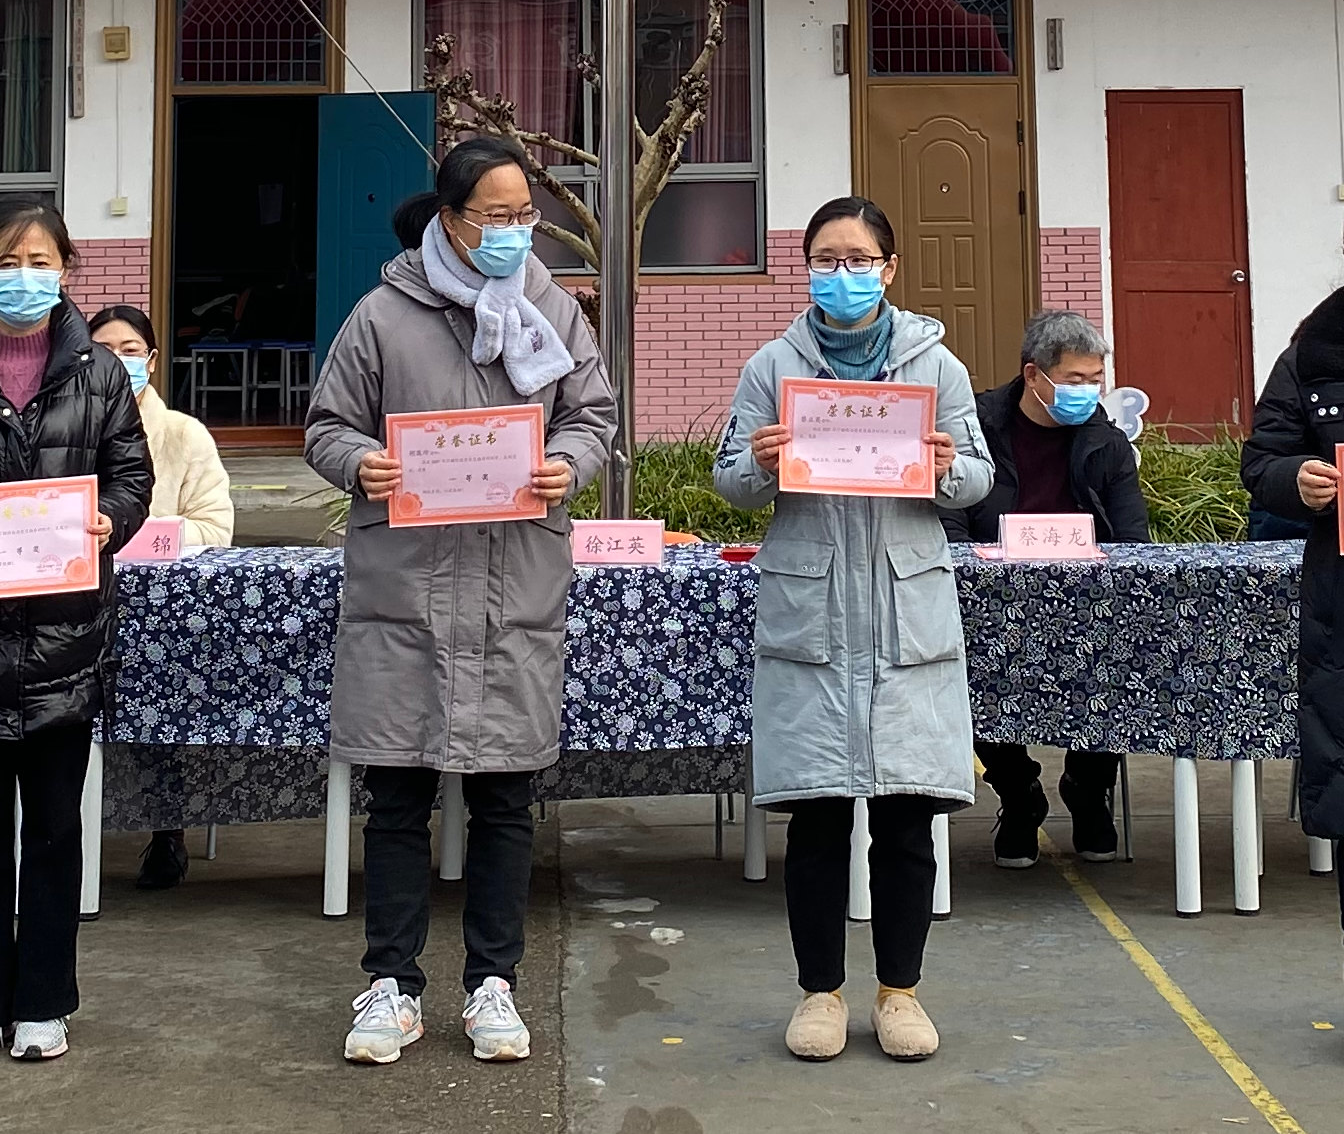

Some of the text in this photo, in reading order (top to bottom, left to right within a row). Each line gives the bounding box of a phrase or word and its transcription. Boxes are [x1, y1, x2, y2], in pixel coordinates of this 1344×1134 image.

[826, 403, 890, 419] 荣誉证书
[434, 431, 498, 449] 荣誉证书
[151, 534, 172, 557] 锦
[584, 535, 645, 555] 徐江英
[1018, 526, 1087, 547] 蔡海龙
